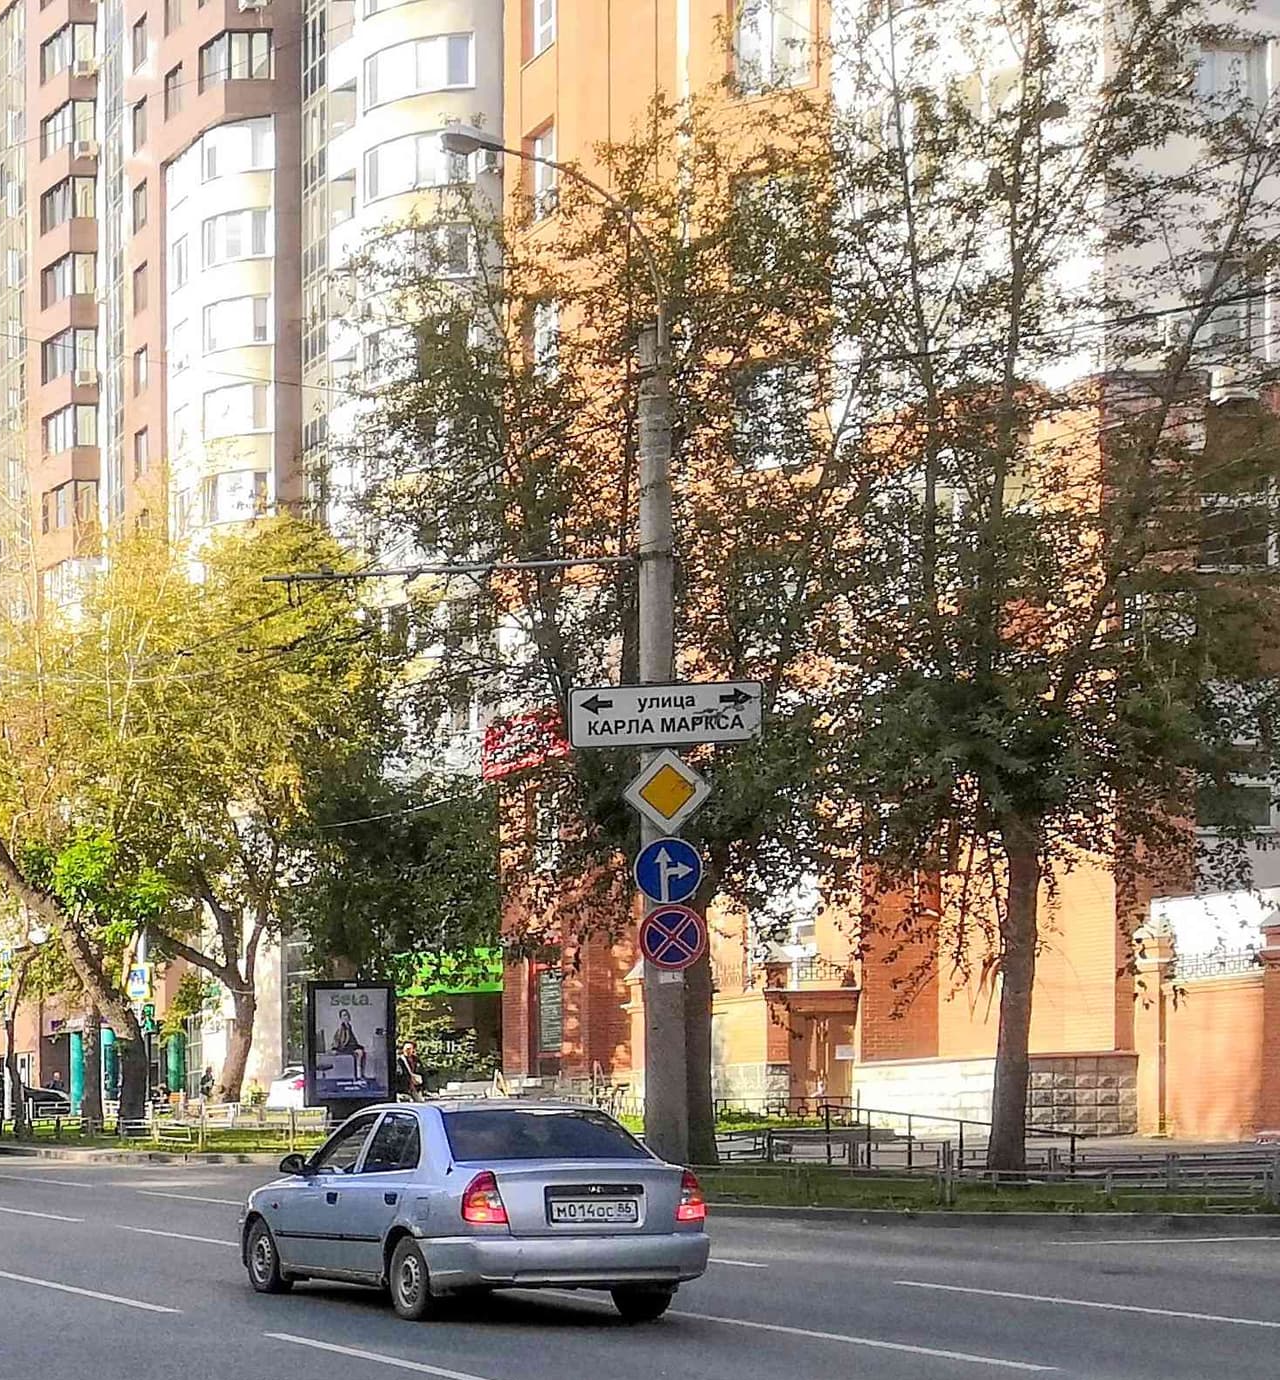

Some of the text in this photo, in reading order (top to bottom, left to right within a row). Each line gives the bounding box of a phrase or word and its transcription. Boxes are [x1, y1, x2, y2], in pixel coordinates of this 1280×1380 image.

[637, 693, 695, 711] улица
[587, 714, 745, 736] КАРЛА МАРКСА
